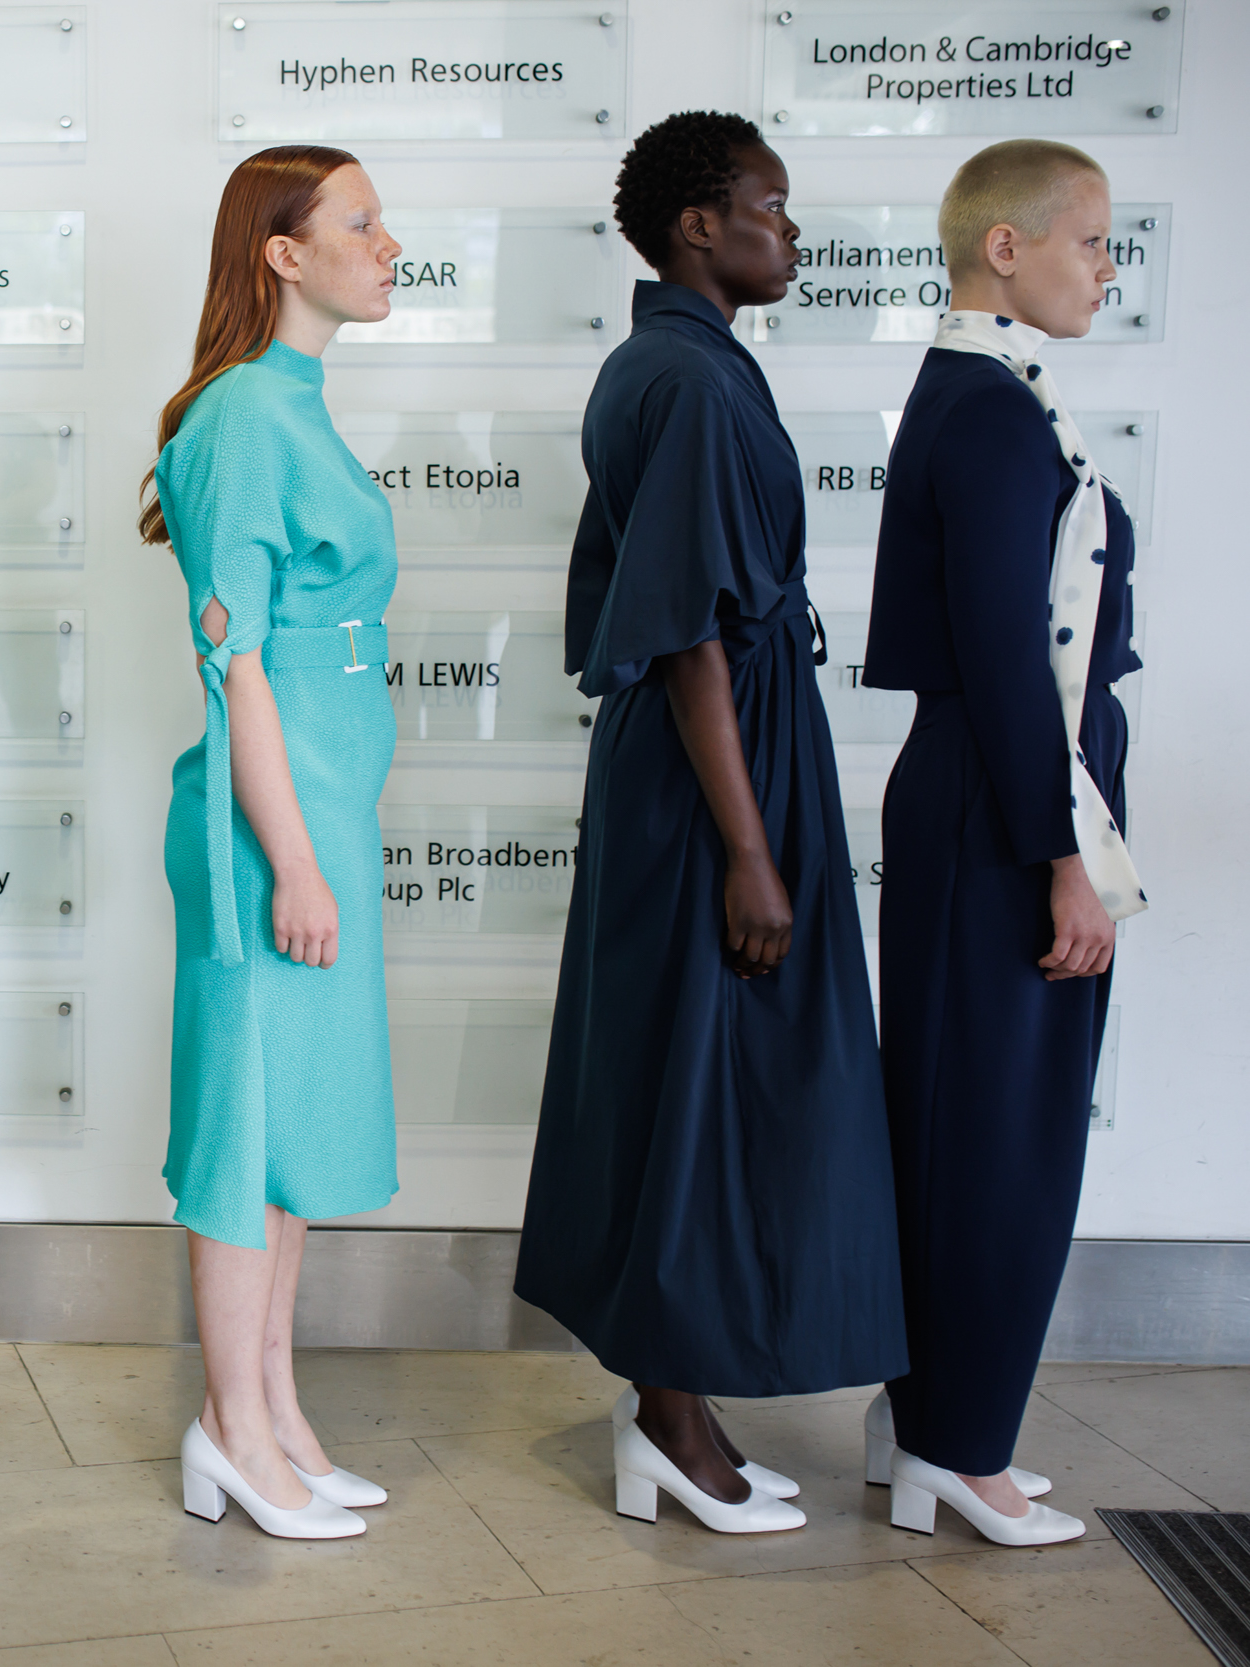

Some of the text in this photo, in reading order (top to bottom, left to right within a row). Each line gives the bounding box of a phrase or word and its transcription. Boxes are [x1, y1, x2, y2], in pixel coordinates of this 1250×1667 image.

[813, 34, 1132, 67] London & Cambridge
[279, 58, 563, 91] Hyphen Resources
[866, 71, 1074, 104] Properties Ltd
[798, 280, 906, 307] Service
[426, 462, 519, 494] Etopia
[818, 466, 854, 490] RB
[419, 663, 500, 686] LEWIS
[428, 842, 578, 867] Broadbent
[438, 877, 475, 901] Plc
